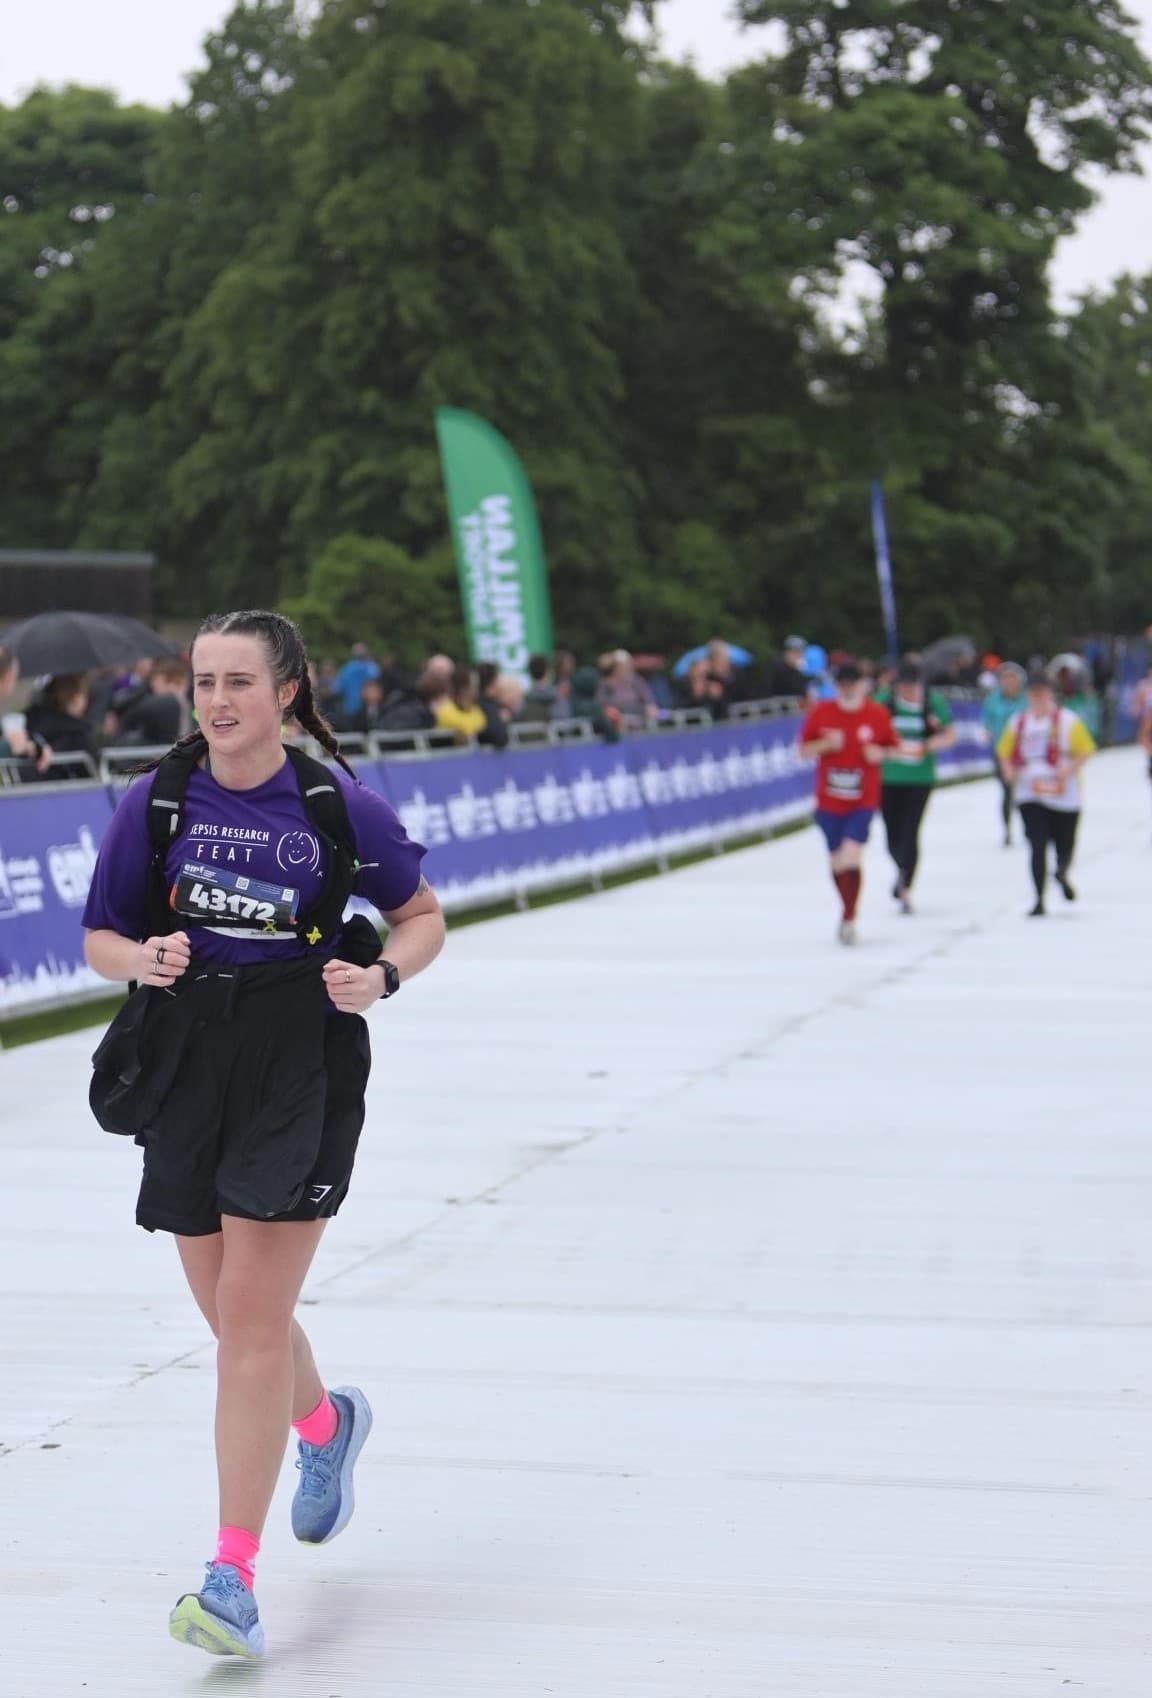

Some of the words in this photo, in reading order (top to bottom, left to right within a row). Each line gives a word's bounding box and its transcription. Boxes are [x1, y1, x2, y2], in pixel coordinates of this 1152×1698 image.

[221, 826, 270, 841] RESEARCH
[196, 844, 253, 863] FEAT
[189, 883, 276, 922] 43172
